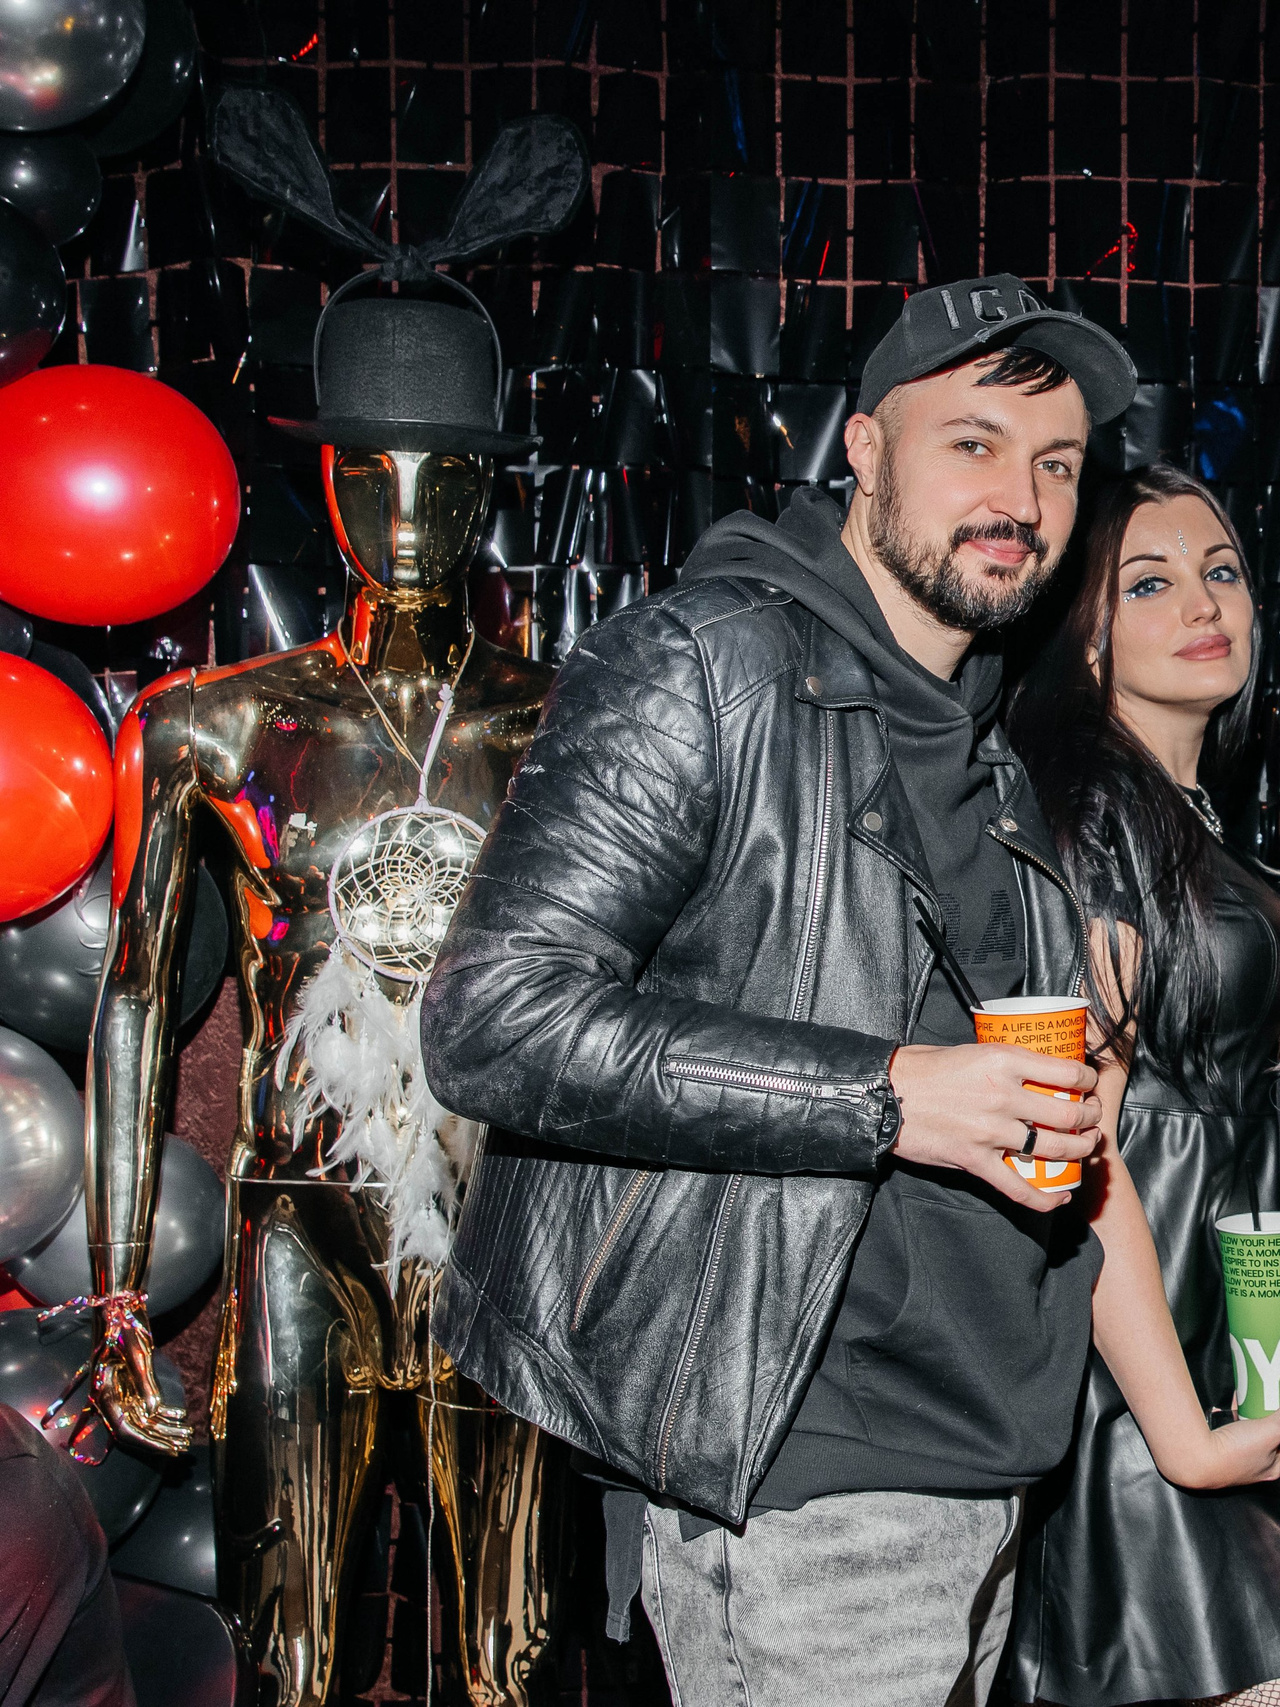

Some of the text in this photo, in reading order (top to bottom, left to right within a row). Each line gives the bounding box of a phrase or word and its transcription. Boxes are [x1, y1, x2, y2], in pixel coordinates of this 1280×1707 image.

[1001, 1023, 1009, 1032] A
[1011, 1022, 1033, 1032] LIFE
[1035, 1021, 1045, 1031] IS
[1047, 1020, 1055, 1030] A
[1014, 1033, 1052, 1045] ASPIRE
[1054, 1031, 1068, 1041] TO
[1036, 1045, 1053, 1055] WE
[1055, 1042, 1077, 1054] NEED
[1240, 1239, 1265, 1247] YOUR
[1237, 1248, 1245, 1257] IS
[1246, 1249, 1254, 1257] A
[1248, 1259, 1261, 1268] TO
[1263, 1258, 1279, 1268] INS
[1230, 1267, 1240, 1277] WE
[1241, 1269, 1264, 1278] NEED
[1266, 1269, 1274, 1278] IS
[1243, 1279, 1267, 1288] YOUR
[1240, 1289, 1248, 1298] IS
[1249, 1290, 1256, 1298] A
